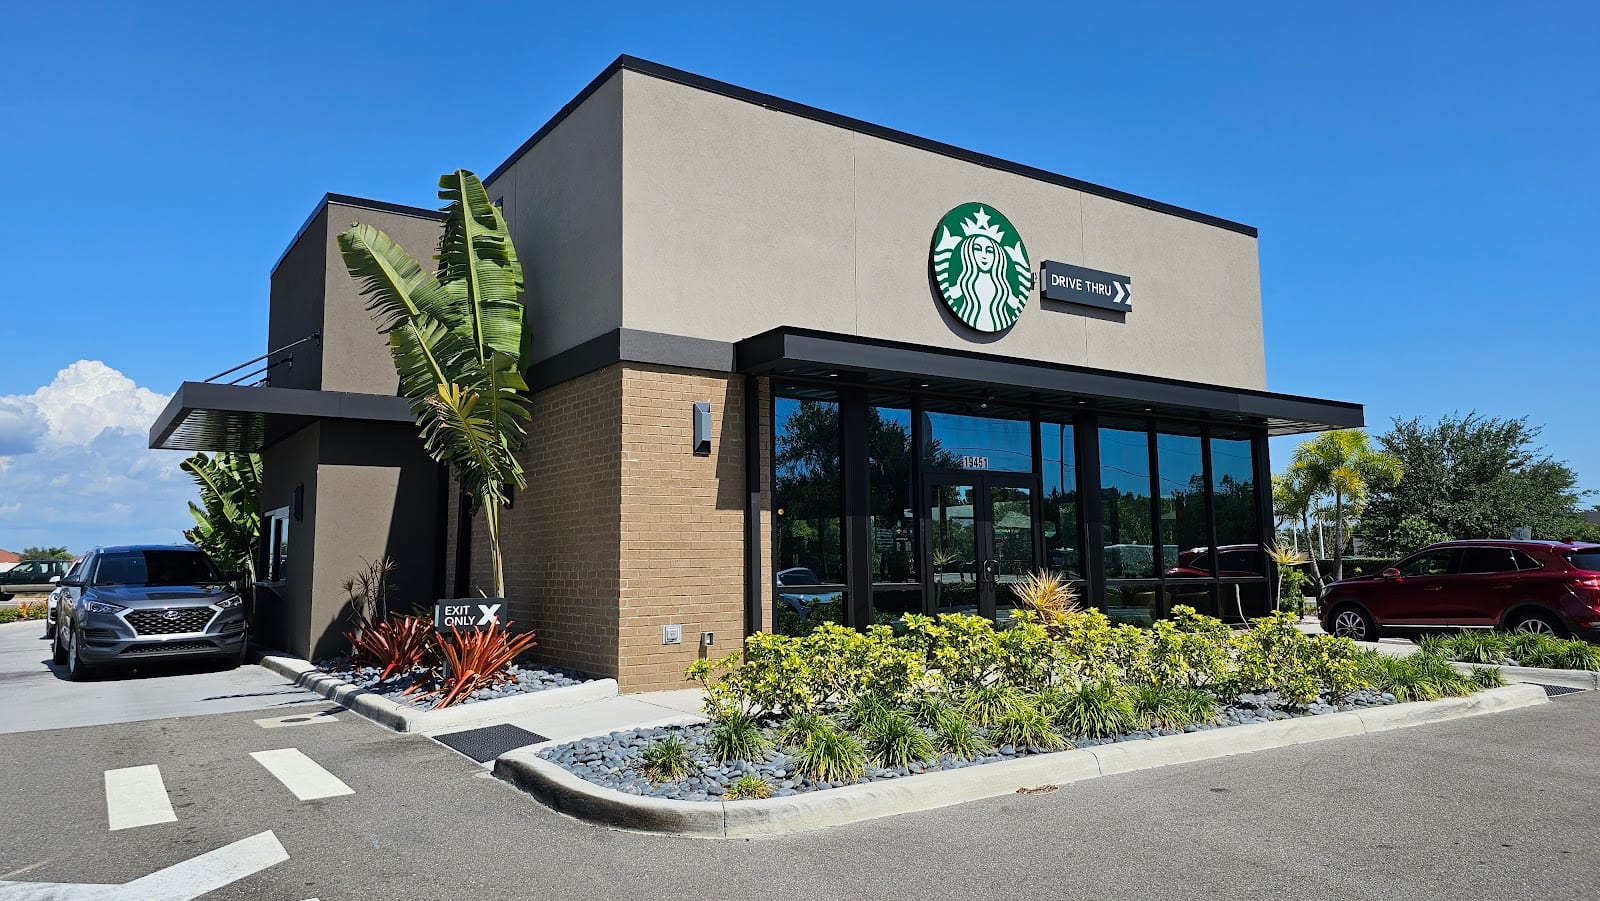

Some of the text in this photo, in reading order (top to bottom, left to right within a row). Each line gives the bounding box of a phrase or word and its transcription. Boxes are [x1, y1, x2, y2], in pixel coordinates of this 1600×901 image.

[1051, 273, 1112, 296] DRIVE THRU
[964, 456, 988, 469] 19451
[444, 605, 470, 616] EXIT
[444, 615, 476, 627] ONLY
